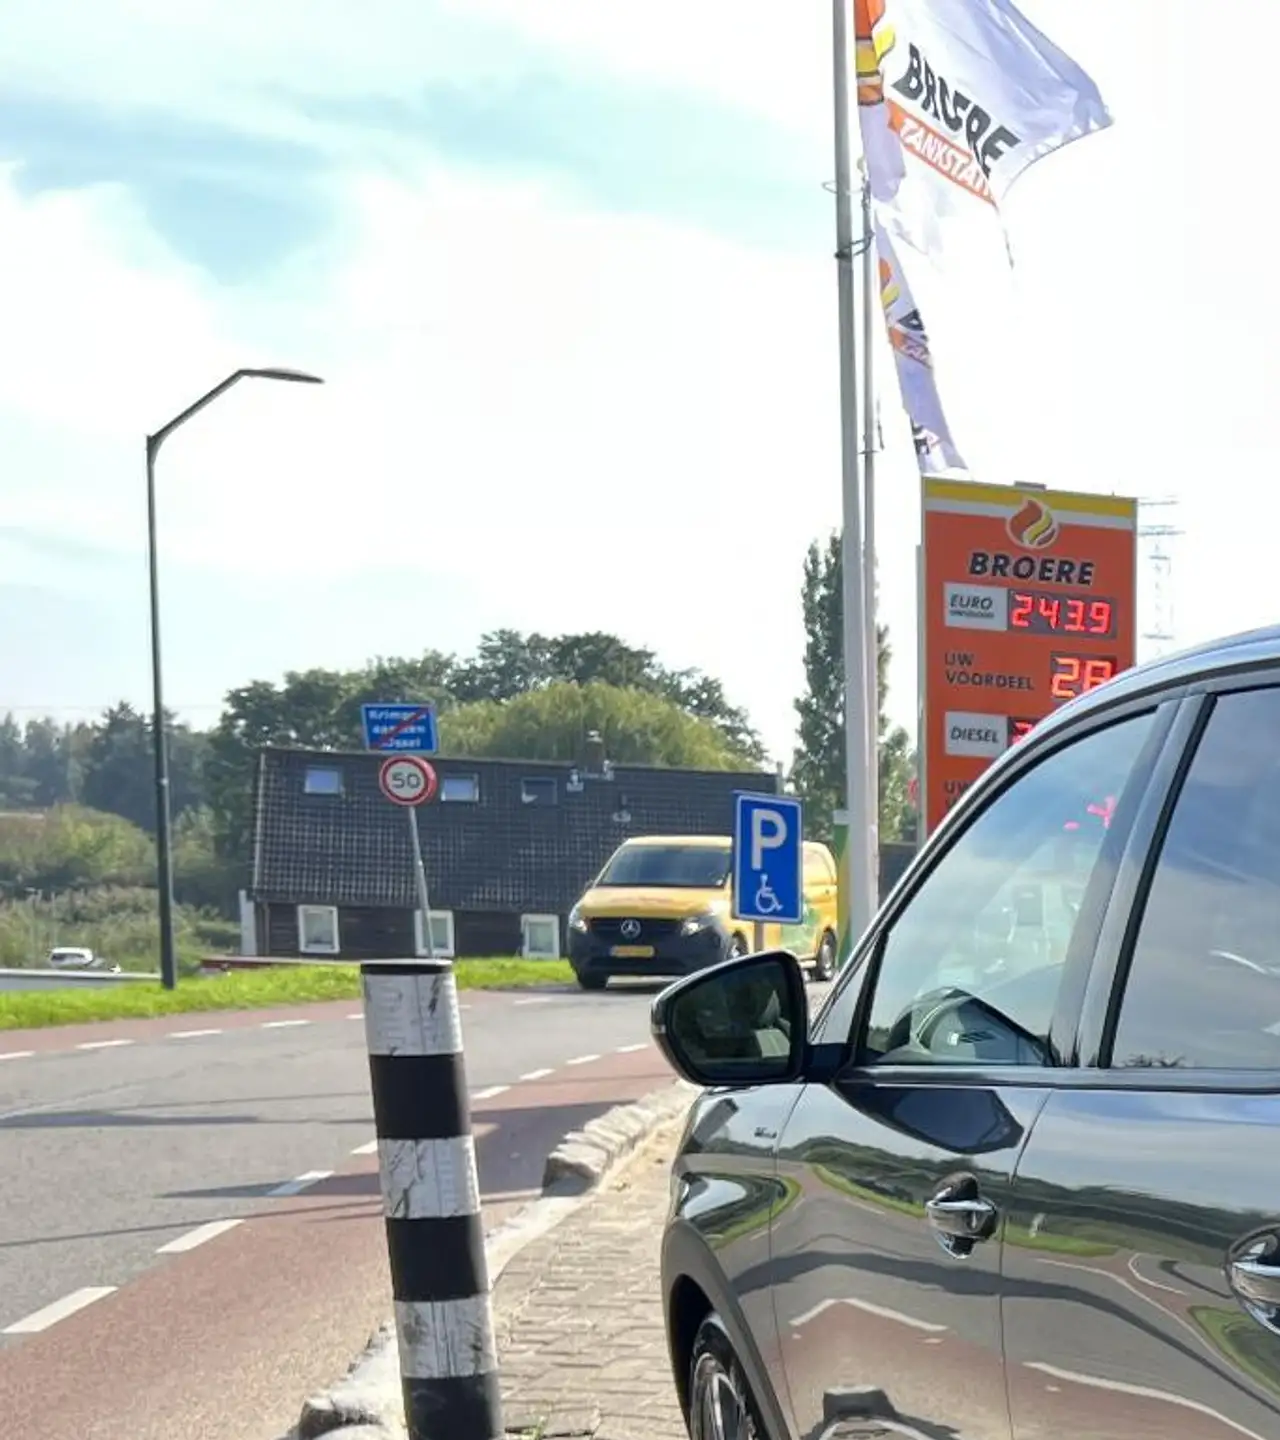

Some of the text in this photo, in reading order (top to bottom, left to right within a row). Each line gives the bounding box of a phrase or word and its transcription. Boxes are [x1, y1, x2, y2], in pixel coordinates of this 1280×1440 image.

[968, 551, 1096, 586] BROERE
[949, 593, 993, 611] EURO
[944, 652, 974, 667] UW
[945, 669, 1035, 691] VOORDEEL
[950, 725, 999, 743] DIESEL
[391, 771, 421, 789] 50
[751, 808, 788, 871] P
